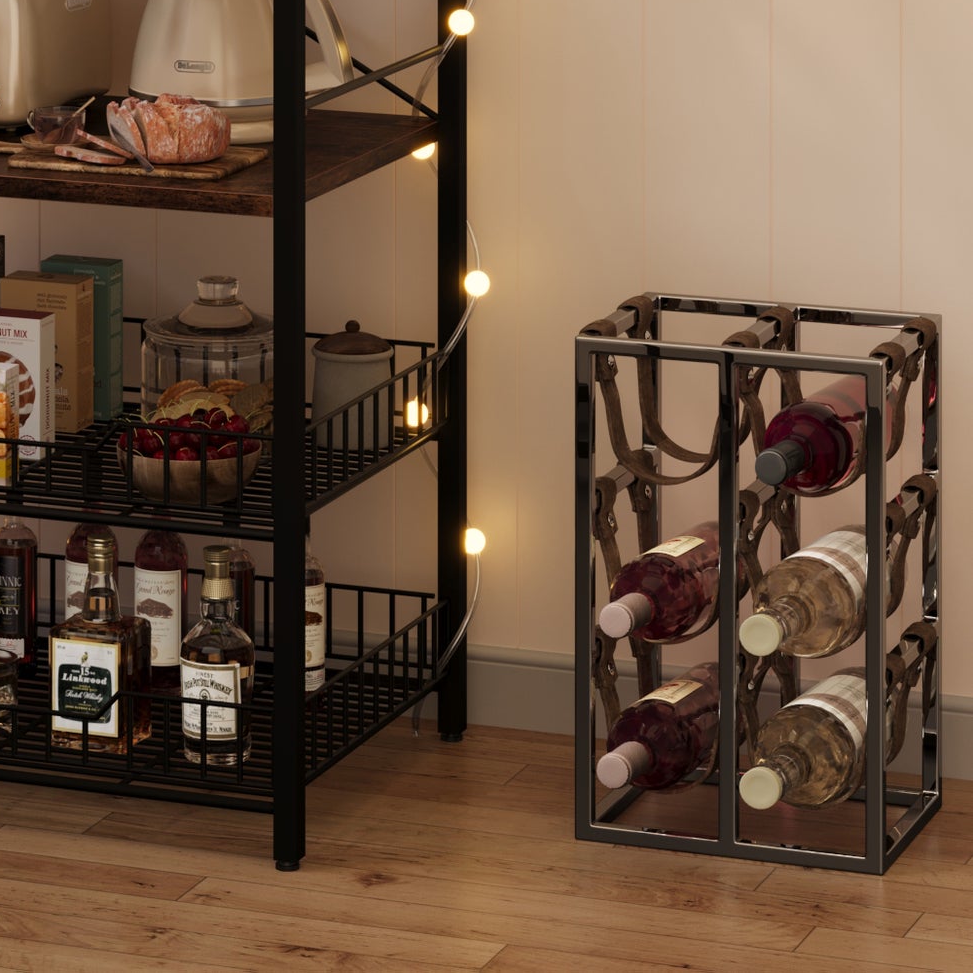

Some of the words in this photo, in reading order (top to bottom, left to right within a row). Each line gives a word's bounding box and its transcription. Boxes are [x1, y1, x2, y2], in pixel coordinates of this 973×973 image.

[13, 329, 28, 338] MIX
[80, 667, 90, 676] 15
[61, 672, 108, 686] Linkwood
